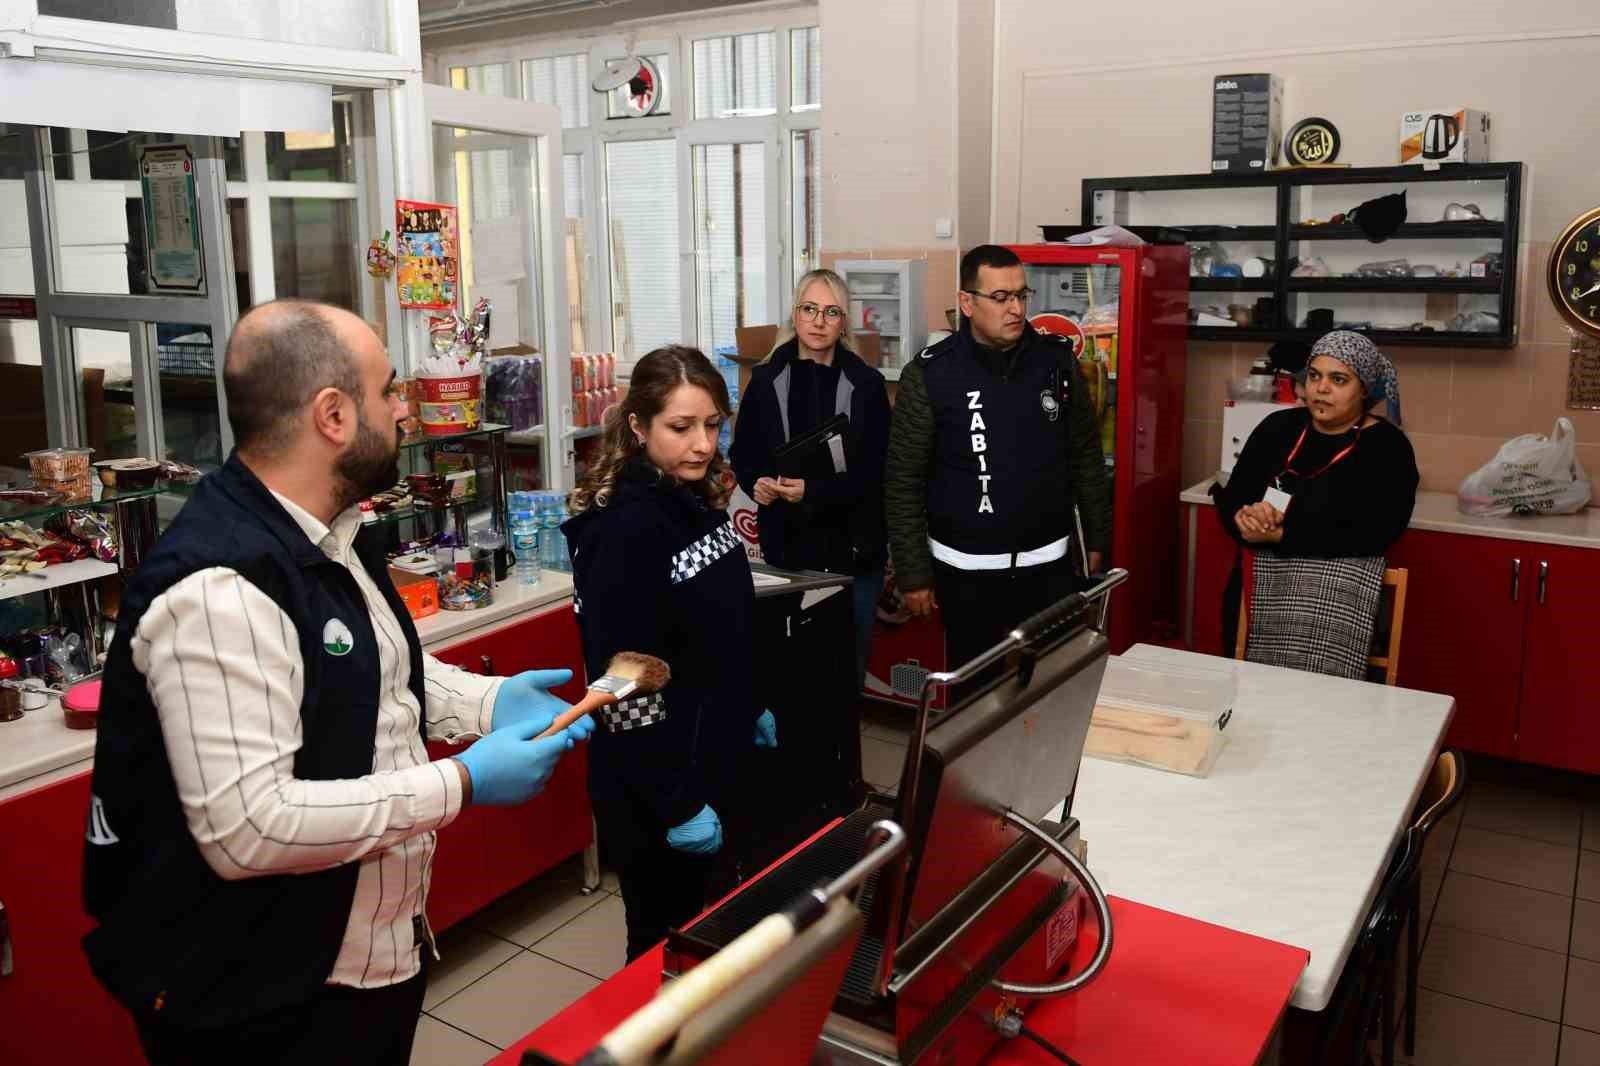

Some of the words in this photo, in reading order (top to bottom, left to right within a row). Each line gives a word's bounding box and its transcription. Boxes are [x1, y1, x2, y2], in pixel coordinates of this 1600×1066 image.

[1575, 240, 1588, 252] 10
[1567, 263, 1576, 276] 9
[1589, 305, 1597, 317] 7
[967, 390, 994, 513] ZABITA
